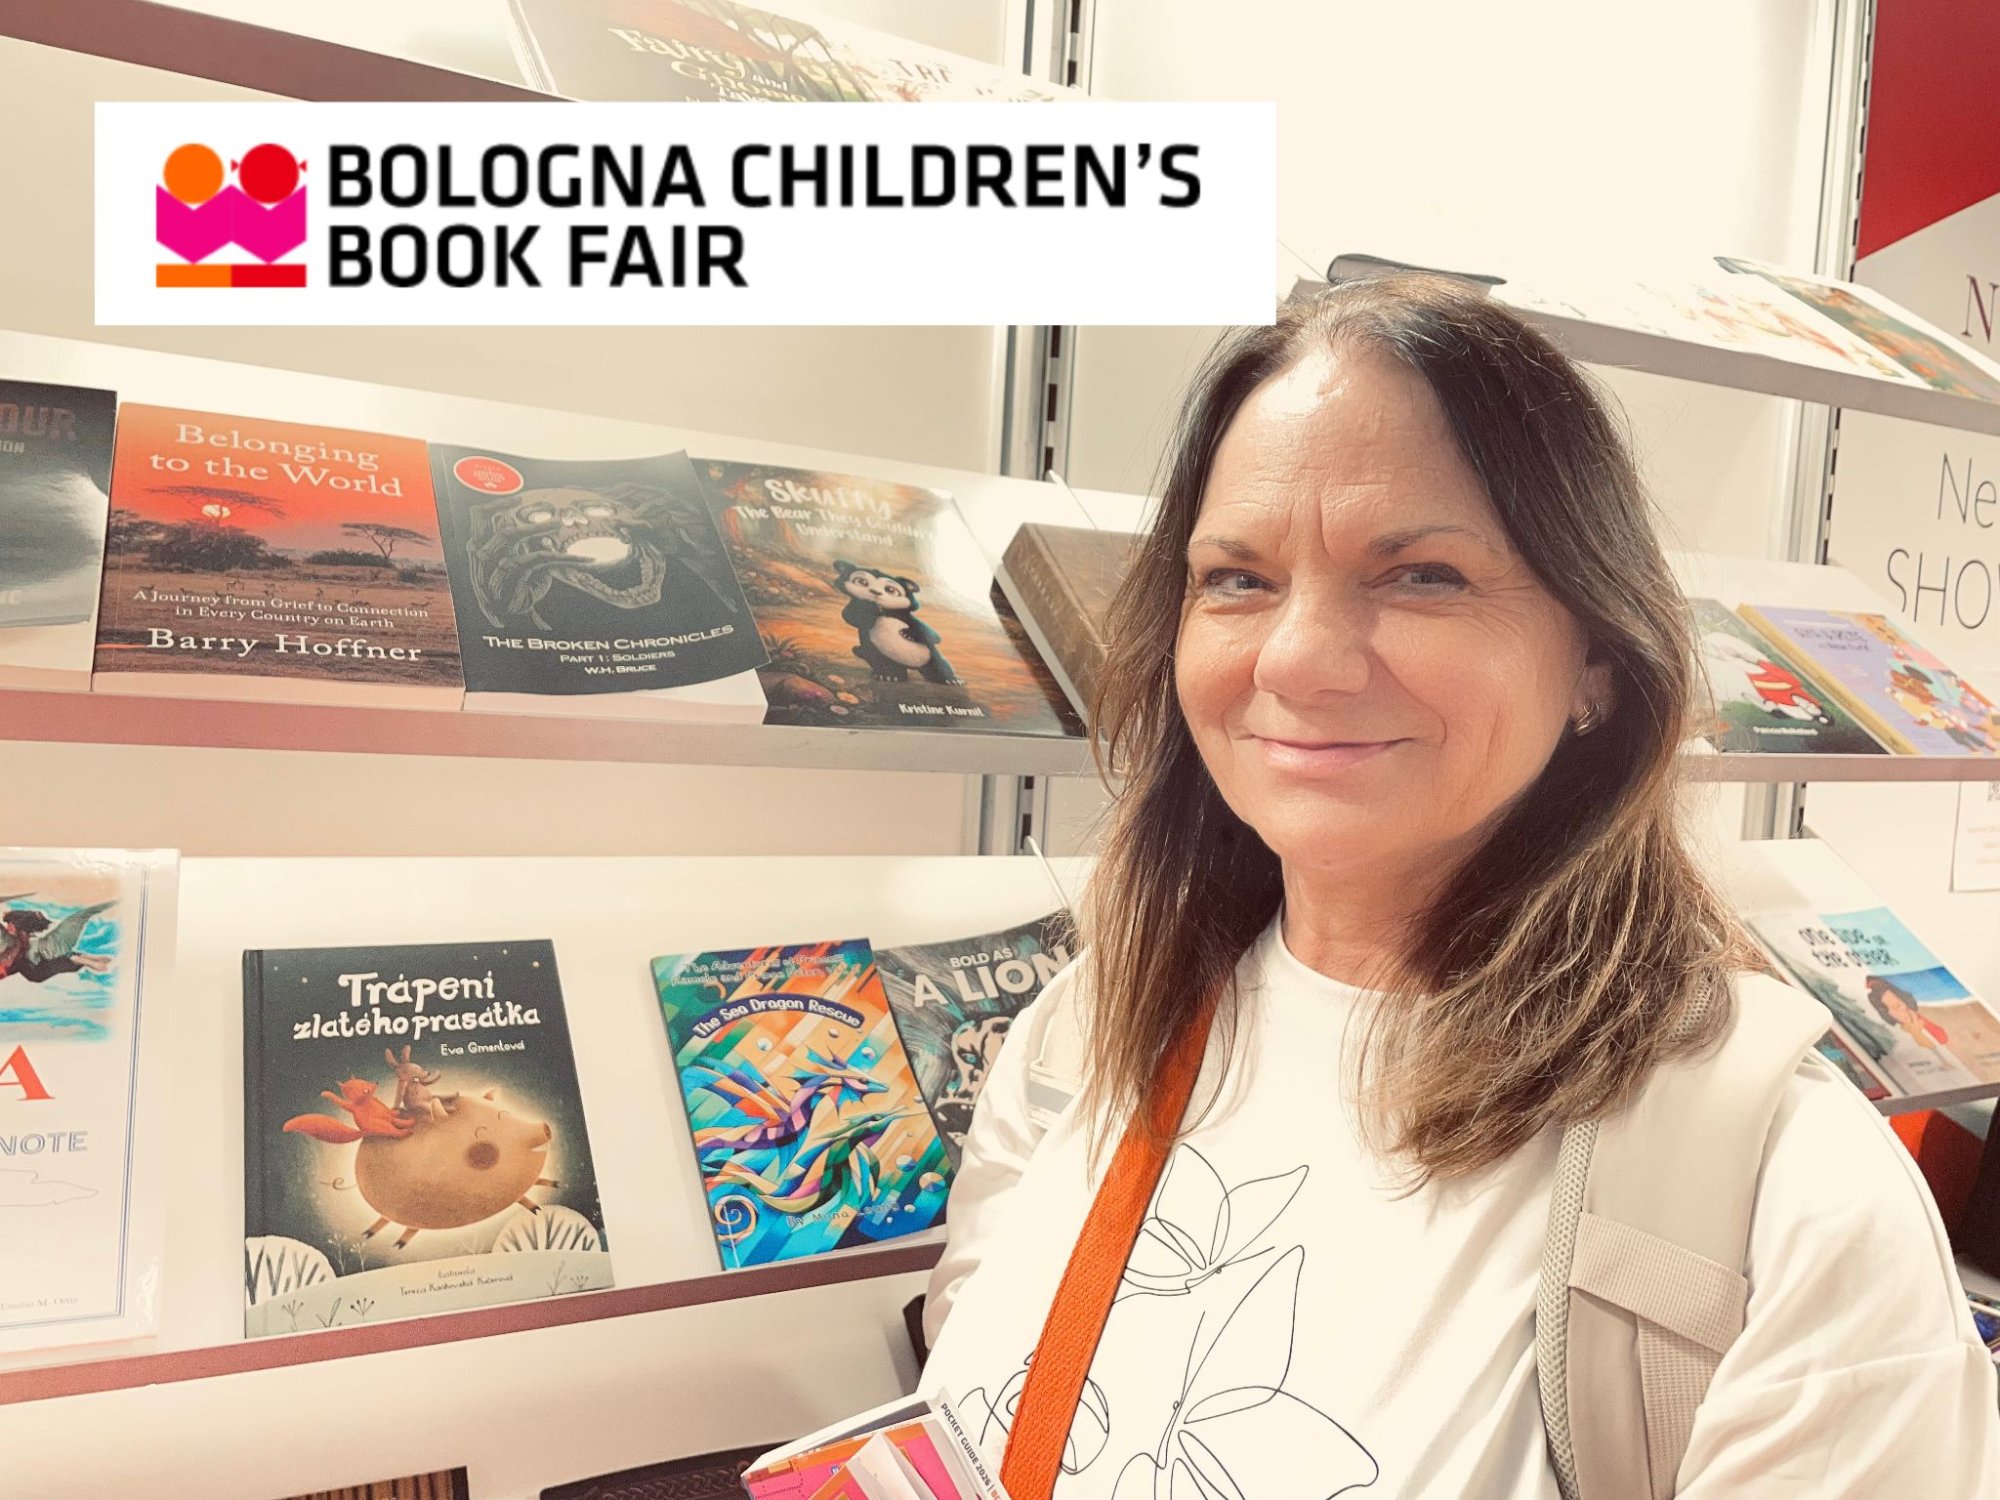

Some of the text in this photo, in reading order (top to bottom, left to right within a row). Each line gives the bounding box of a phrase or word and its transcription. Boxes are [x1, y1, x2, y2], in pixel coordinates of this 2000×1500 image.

[0, 441, 25, 453] ON
[175, 422, 379, 471] Belonging
[150, 453, 404, 497] to the World
[1938, 453, 1998, 529] Ne
[733, 505, 769, 520] The
[769, 505, 812, 521] Bear
[815, 508, 861, 527] They
[795, 522, 894, 547] Understand
[1887, 548, 2000, 630] SHO
[133, 590, 429, 618] A Journey from Grief to Connection
[175, 605, 395, 628] in Every Country on Earth
[146, 627, 422, 662] Barry Hoffner
[482, 624, 735, 651] THE BROKEN CHRONICLES
[560, 653, 593, 664] PART
[612, 650, 676, 663] SOLDIERS
[616, 664, 657, 674] BRUCE
[898, 703, 945, 715] Kristine
[950, 947, 1014, 969] BOLD AS
[913, 944, 1071, 1008] A LION
[293, 1000, 541, 1041] zlatého prasátka
[692, 998, 861, 1036] The Sea Dragon Rescue
[440, 1043, 465, 1057] Eva
[0, 1044, 56, 1101] A
[0, 1130, 89, 1156] NOTE
[940, 1402, 964, 1438] POCKET
[960, 1437, 980, 1465] GUIDE
[975, 1463, 992, 1487] 2026
